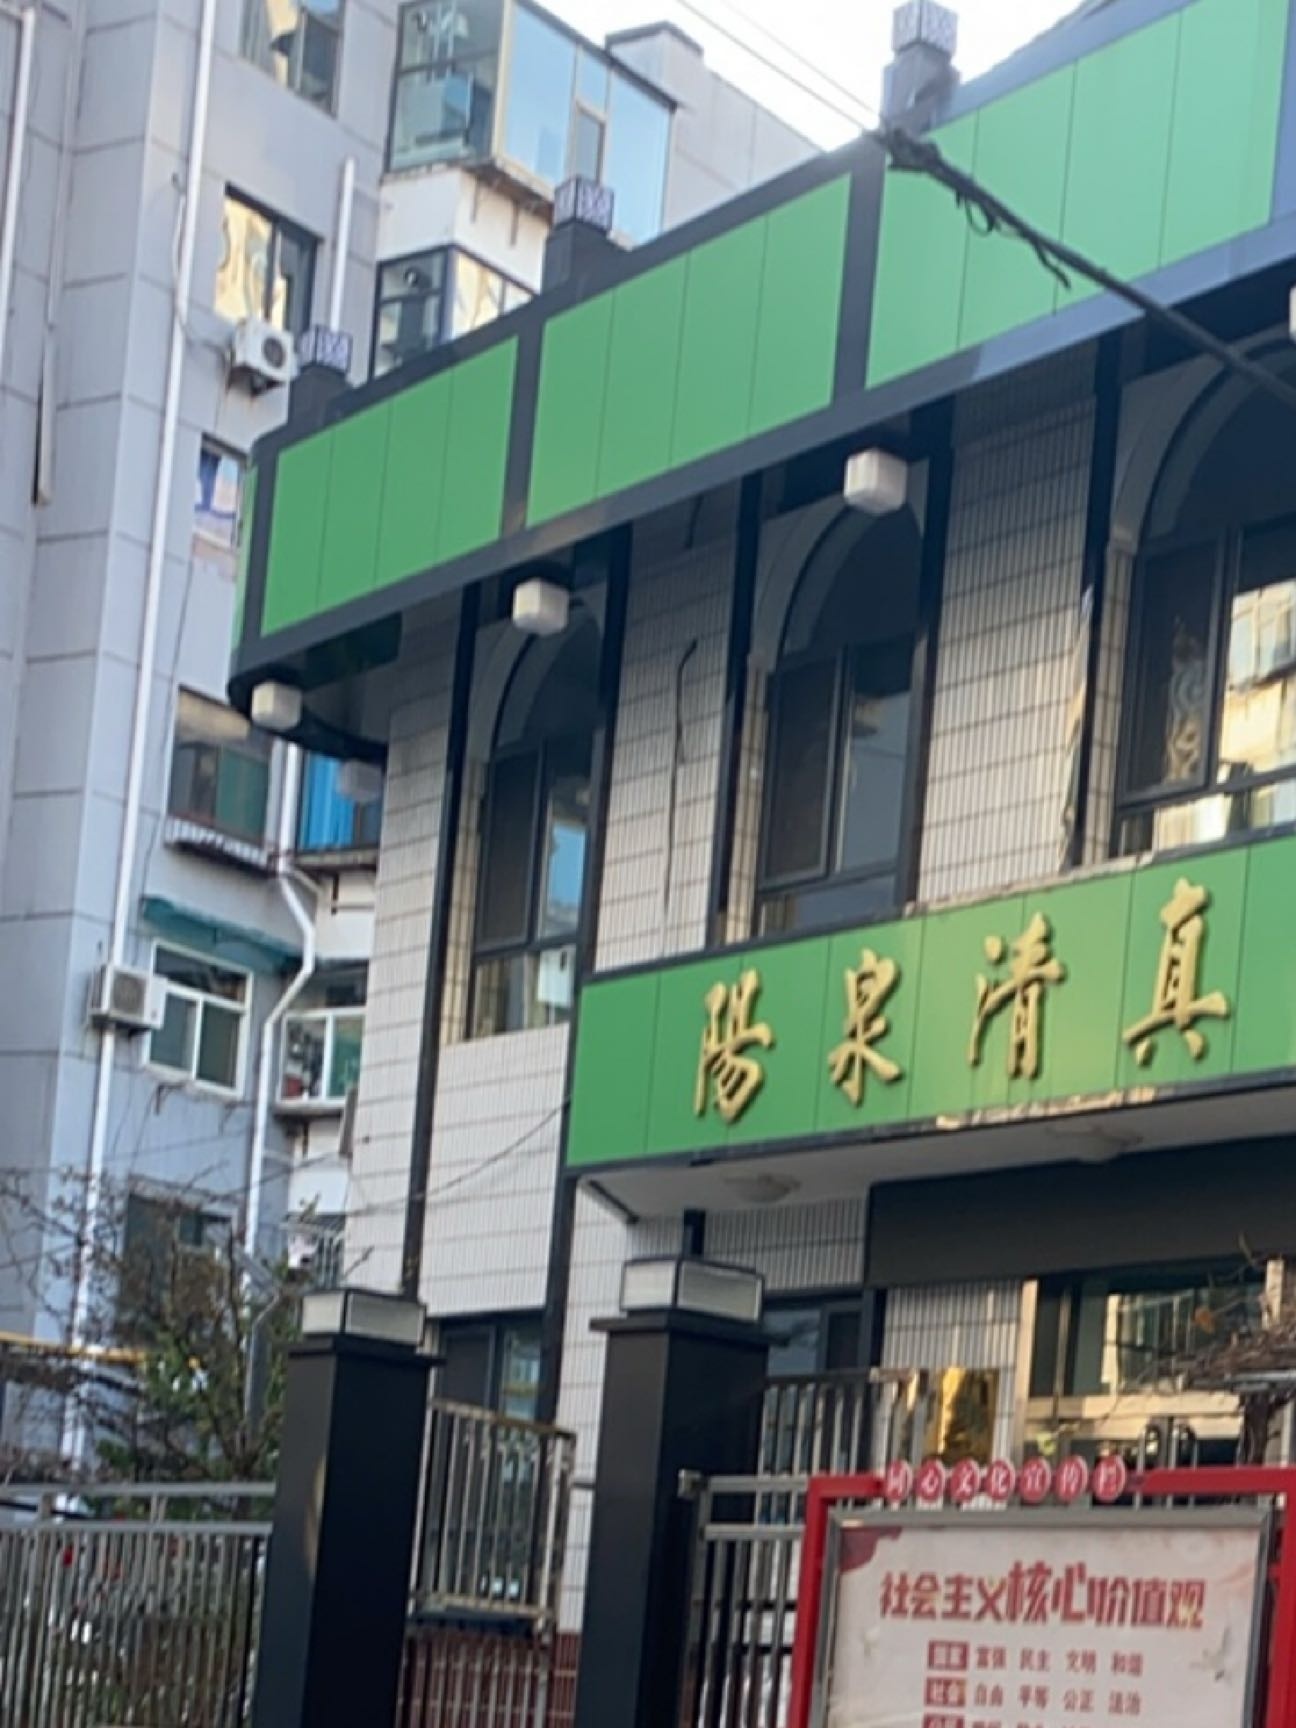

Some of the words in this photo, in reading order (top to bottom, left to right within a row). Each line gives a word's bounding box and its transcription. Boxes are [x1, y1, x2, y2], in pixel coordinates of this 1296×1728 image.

[880, 1560, 1206, 1629] 社会主义核心价值观
